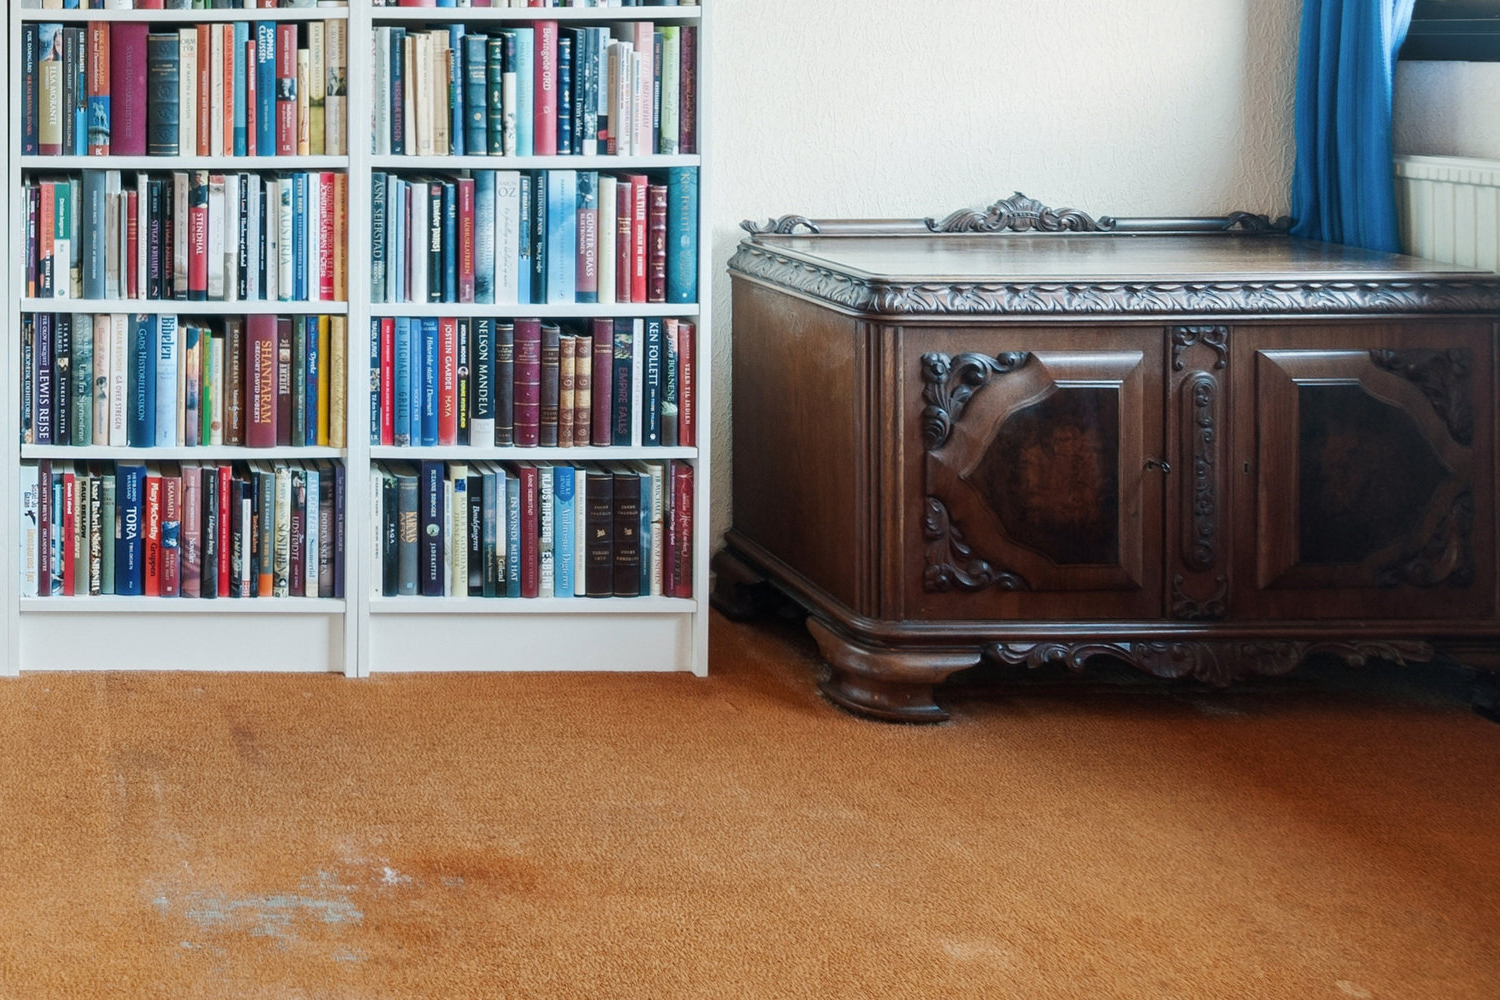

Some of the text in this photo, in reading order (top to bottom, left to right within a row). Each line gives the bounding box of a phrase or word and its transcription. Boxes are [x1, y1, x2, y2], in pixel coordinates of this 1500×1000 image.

[258, 26, 266, 63] CLAUSSEN
[541, 28, 551, 90] Bevingede ORD
[374, 180, 385, 258] ÅSNE SEIERSTAD
[586, 213, 594, 277] GÜNTER GRASS
[161, 317, 175, 360] Bibelen
[478, 320, 488, 415] NELSON MANDELA
[649, 322, 658, 386] KEN FOLLETT
[38, 370, 49, 439] LEWIS REJSE
[116, 376, 123, 385] GÅ
[138, 352, 147, 421] HISTORIELEKSIKON
[261, 341, 271, 424] SHANTARAM
[619, 367, 627, 434] EMPIRE FALLS
[126, 506, 136, 540] TORA
[149, 482, 158, 576] Mary McCarthy Gruppen
[406, 512, 417, 543] KARNAS
[472, 506, 480, 551] Bondefangeren
[511, 497, 517, 508] EN
[542, 474, 552, 589] KLAUS RIFBJERG ESBERN
[291, 516, 299, 560] UDSTØDTE
